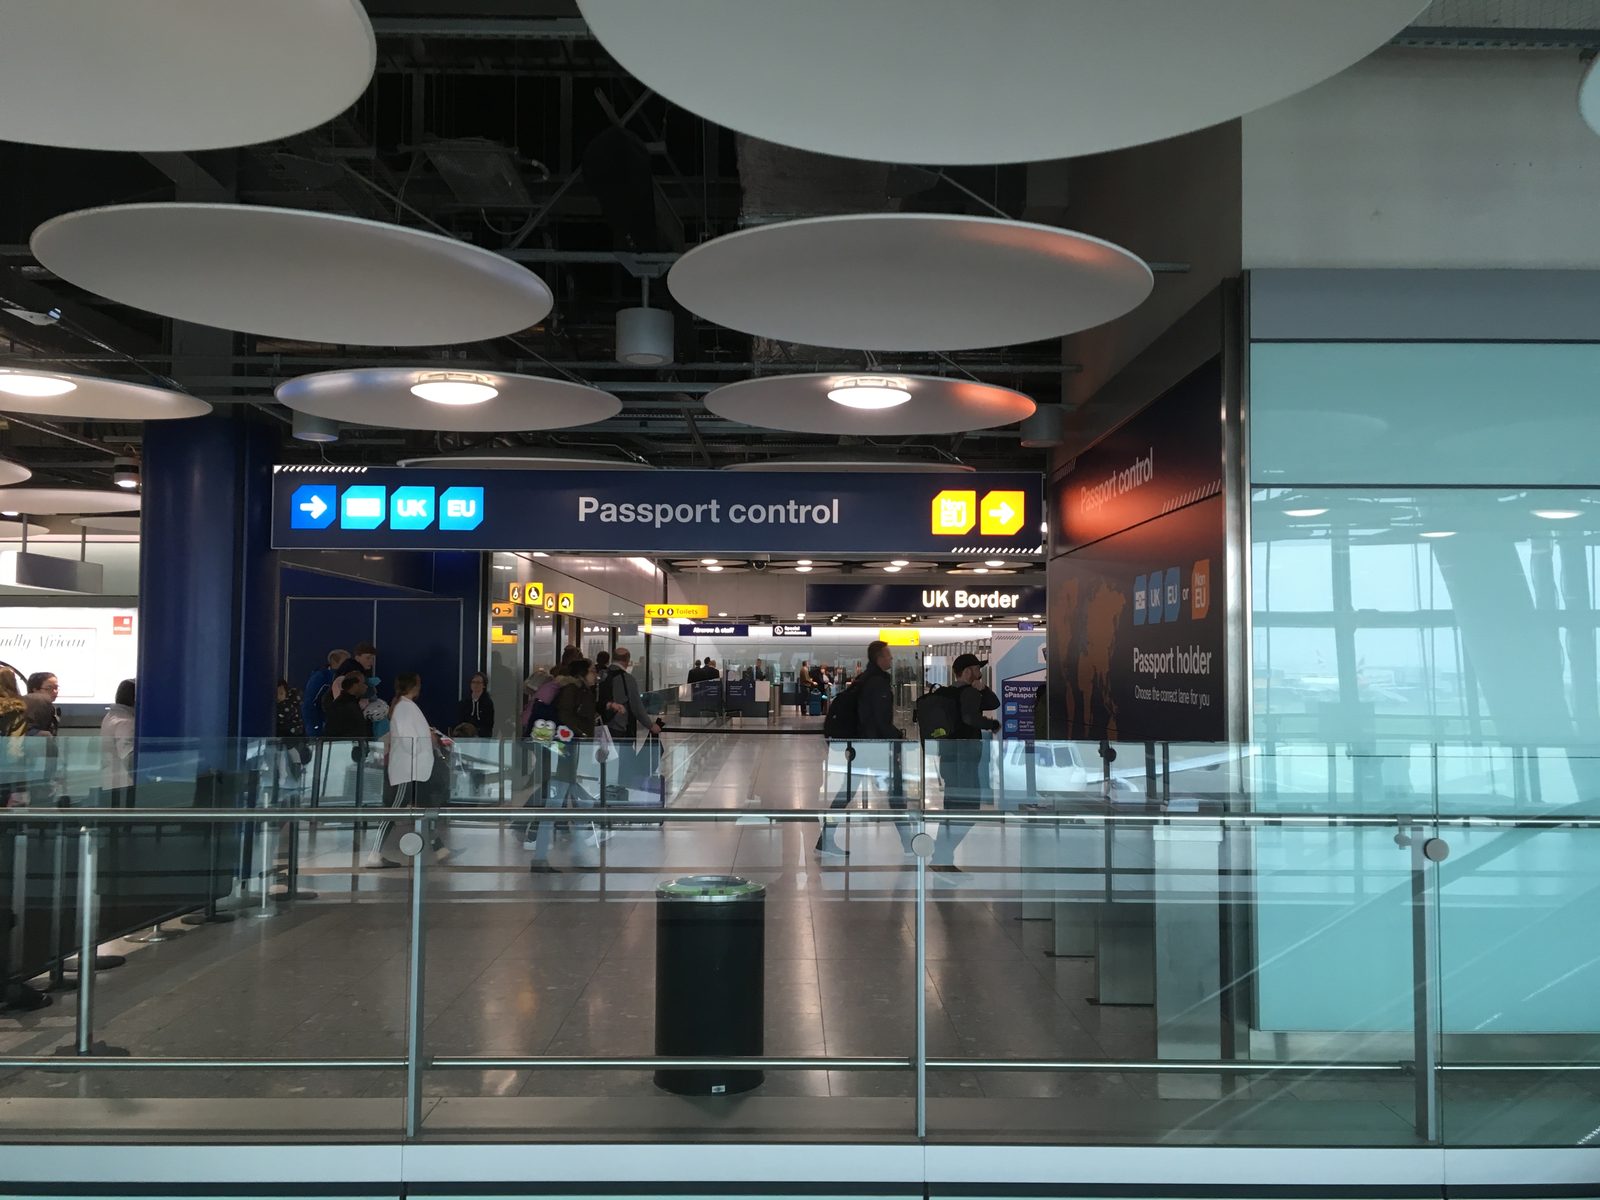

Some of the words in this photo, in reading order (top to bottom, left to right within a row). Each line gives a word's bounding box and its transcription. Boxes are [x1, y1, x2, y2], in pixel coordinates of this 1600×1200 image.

[1080, 471, 1117, 515] Passport
[1118, 447, 1153, 493] control
[396, 499, 427, 518] UK
[447, 499, 476, 518] EU
[578, 496, 721, 529] Passport
[728, 498, 839, 524] control
[922, 590, 950, 608] UK
[954, 590, 1020, 608] Border
[1150, 588, 1161, 607] UK
[1167, 584, 1178, 605] EU
[1182, 588, 1189, 601] or
[1195, 587, 1206, 609] EU
[1133, 647, 1175, 679] Passport
[1177, 645, 1212, 675] holder
[1134, 684, 1152, 700] Choose
[1152, 686, 1160, 701] the
[1160, 688, 1178, 703] correct
[1178, 688, 1190, 705] lane
[1190, 688, 1199, 705] for
[1199, 694, 1210, 710] you
